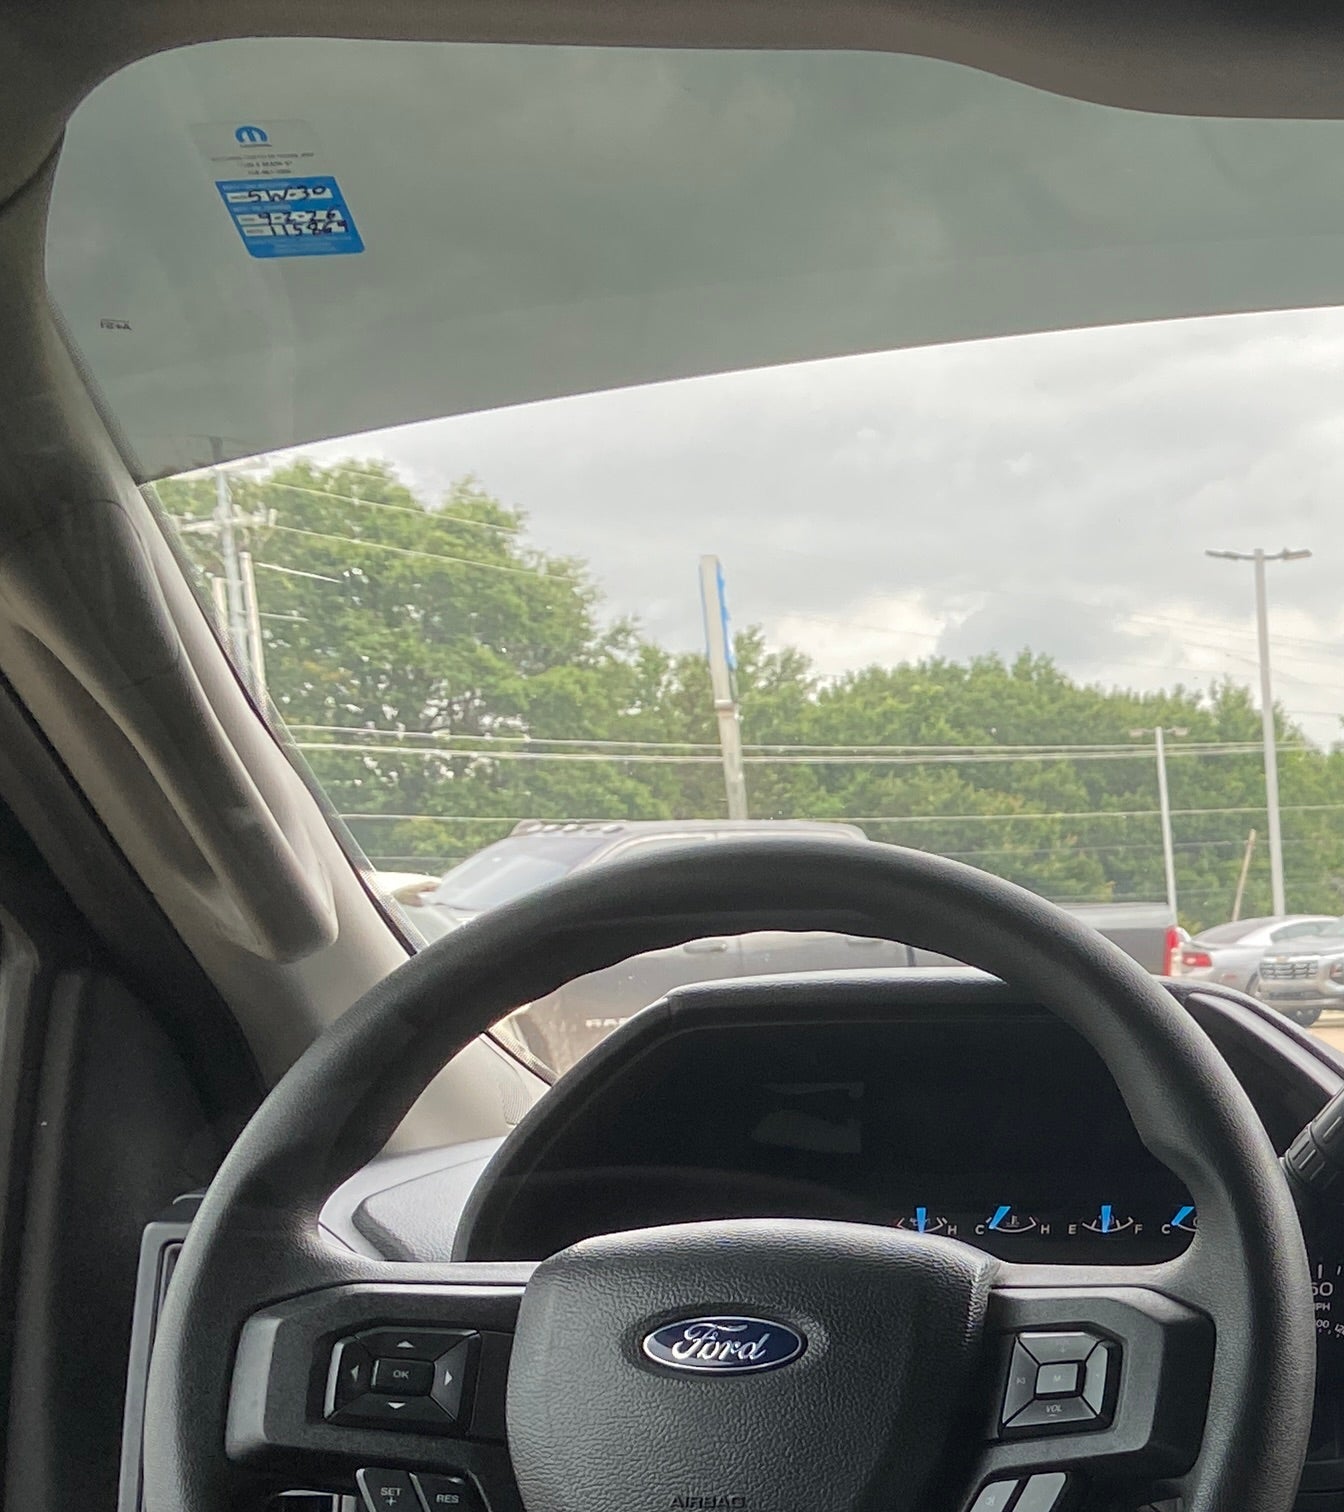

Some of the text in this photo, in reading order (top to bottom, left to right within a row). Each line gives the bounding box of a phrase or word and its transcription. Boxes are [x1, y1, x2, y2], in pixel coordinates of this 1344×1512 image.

[947, 1225, 957, 1235] H
[975, 1225, 985, 1235] C
[1040, 1225, 1050, 1235] H
[1069, 1225, 1077, 1235] E
[1135, 1225, 1143, 1235] F
[1161, 1225, 1171, 1235] C
[671, 1322, 771, 1360] Ford
[393, 1369, 410, 1380] OK
[381, 1487, 402, 1497] SET
[436, 1494, 459, 1504] RES
[670, 1494, 746, 1509] AIRBAG
